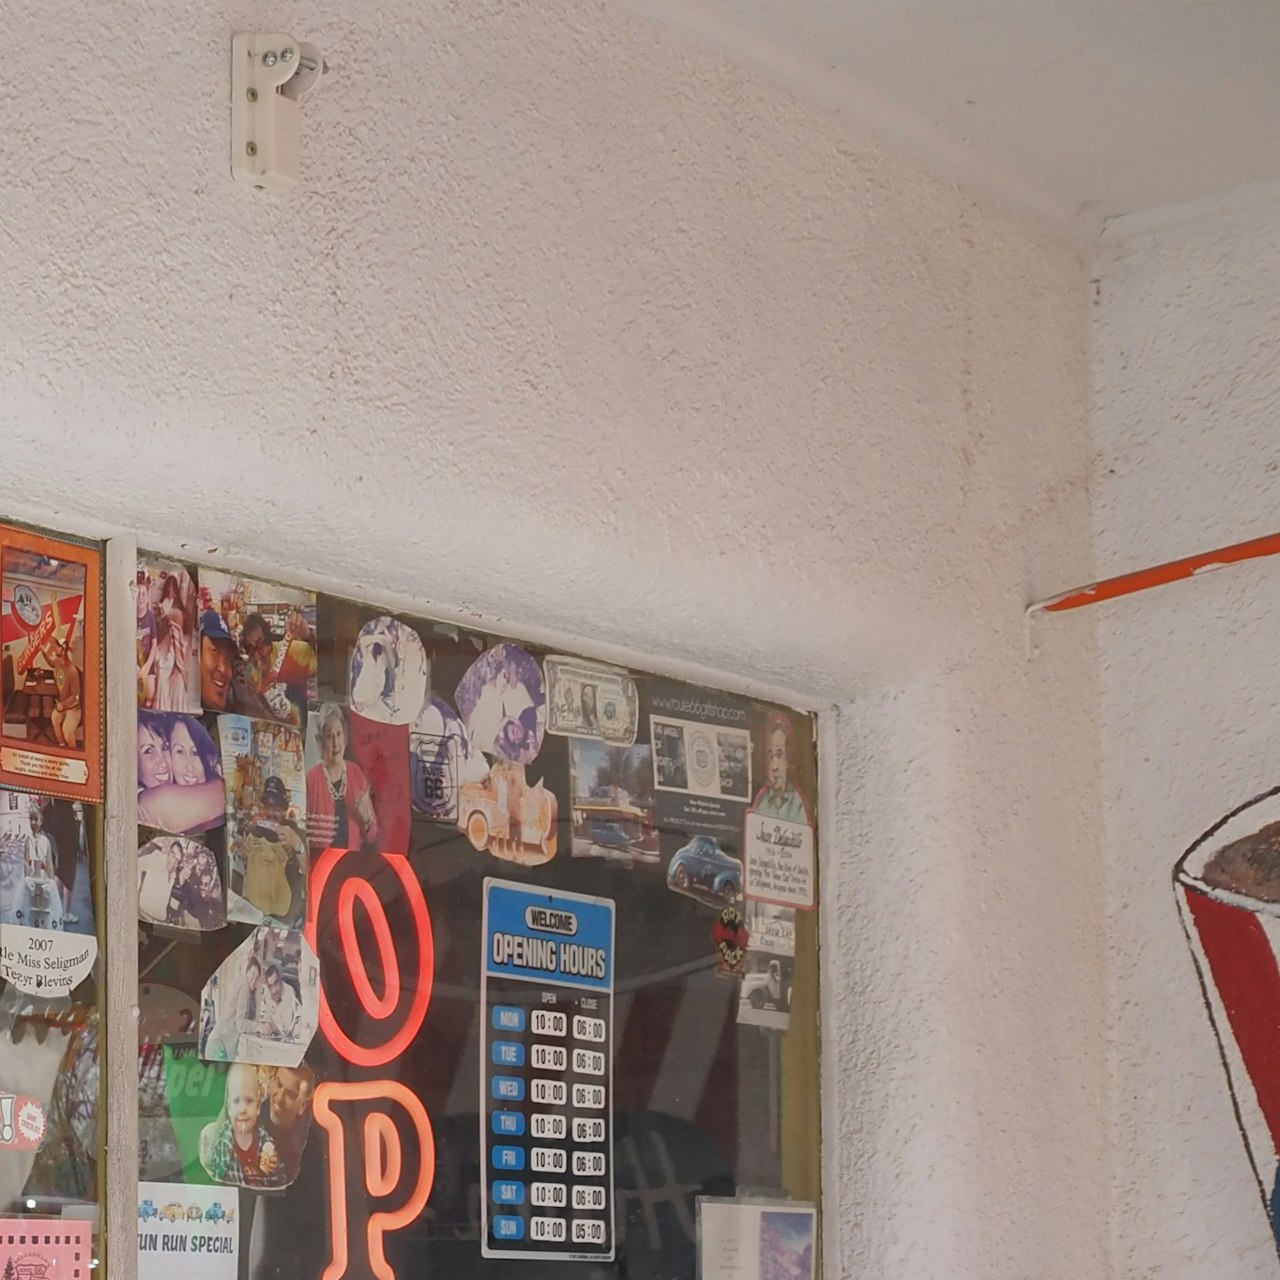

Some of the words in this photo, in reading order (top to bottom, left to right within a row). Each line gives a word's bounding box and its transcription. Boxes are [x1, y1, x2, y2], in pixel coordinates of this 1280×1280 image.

[424, 777, 444, 800] 66
[531, 909, 573, 932] WELCOME
[28, 937, 53, 951] 2007
[17, 952, 41, 968] Miss
[44, 949, 89, 971] Seligman
[493, 932, 556, 971] OPENING
[560, 943, 606, 979] HOURS
[36, 974, 73, 988] Blevins
[542, 992, 557, 1003] OPEN
[580, 998, 597, 1009] CLOSE
[500, 1011, 519, 1027] MON
[536, 1014, 563, 1032] 10:00
[577, 1019, 603, 1039] 06:00
[501, 1046, 517, 1062] TUE
[536, 1048, 563, 1066] 10:00
[576, 1053, 601, 1071] 06:00
[500, 1081, 518, 1096] WED
[536, 1083, 563, 1100] 10:00
[576, 1088, 601, 1104] 06:00
[500, 1115, 516, 1131] THU
[536, 1118, 563, 1135] 10:00
[577, 1122, 601, 1138] 06:00
[502, 1150, 516, 1165] FRI
[536, 1152, 563, 1169] 10:00
[576, 1156, 601, 1172] 06:00
[501, 1184, 517, 1200] SAT
[536, 1186, 563, 1203] 10:00
[576, 1190, 601, 1206] 06:00
[500, 1219, 516, 1235] SUN
[535, 1220, 563, 1238] 10:00
[576, 1223, 601, 1239] 05:00
[138, 1233, 159, 1252] UN
[162, 1234, 187, 1253] RUN
[190, 1235, 233, 1254] SPECIAL
